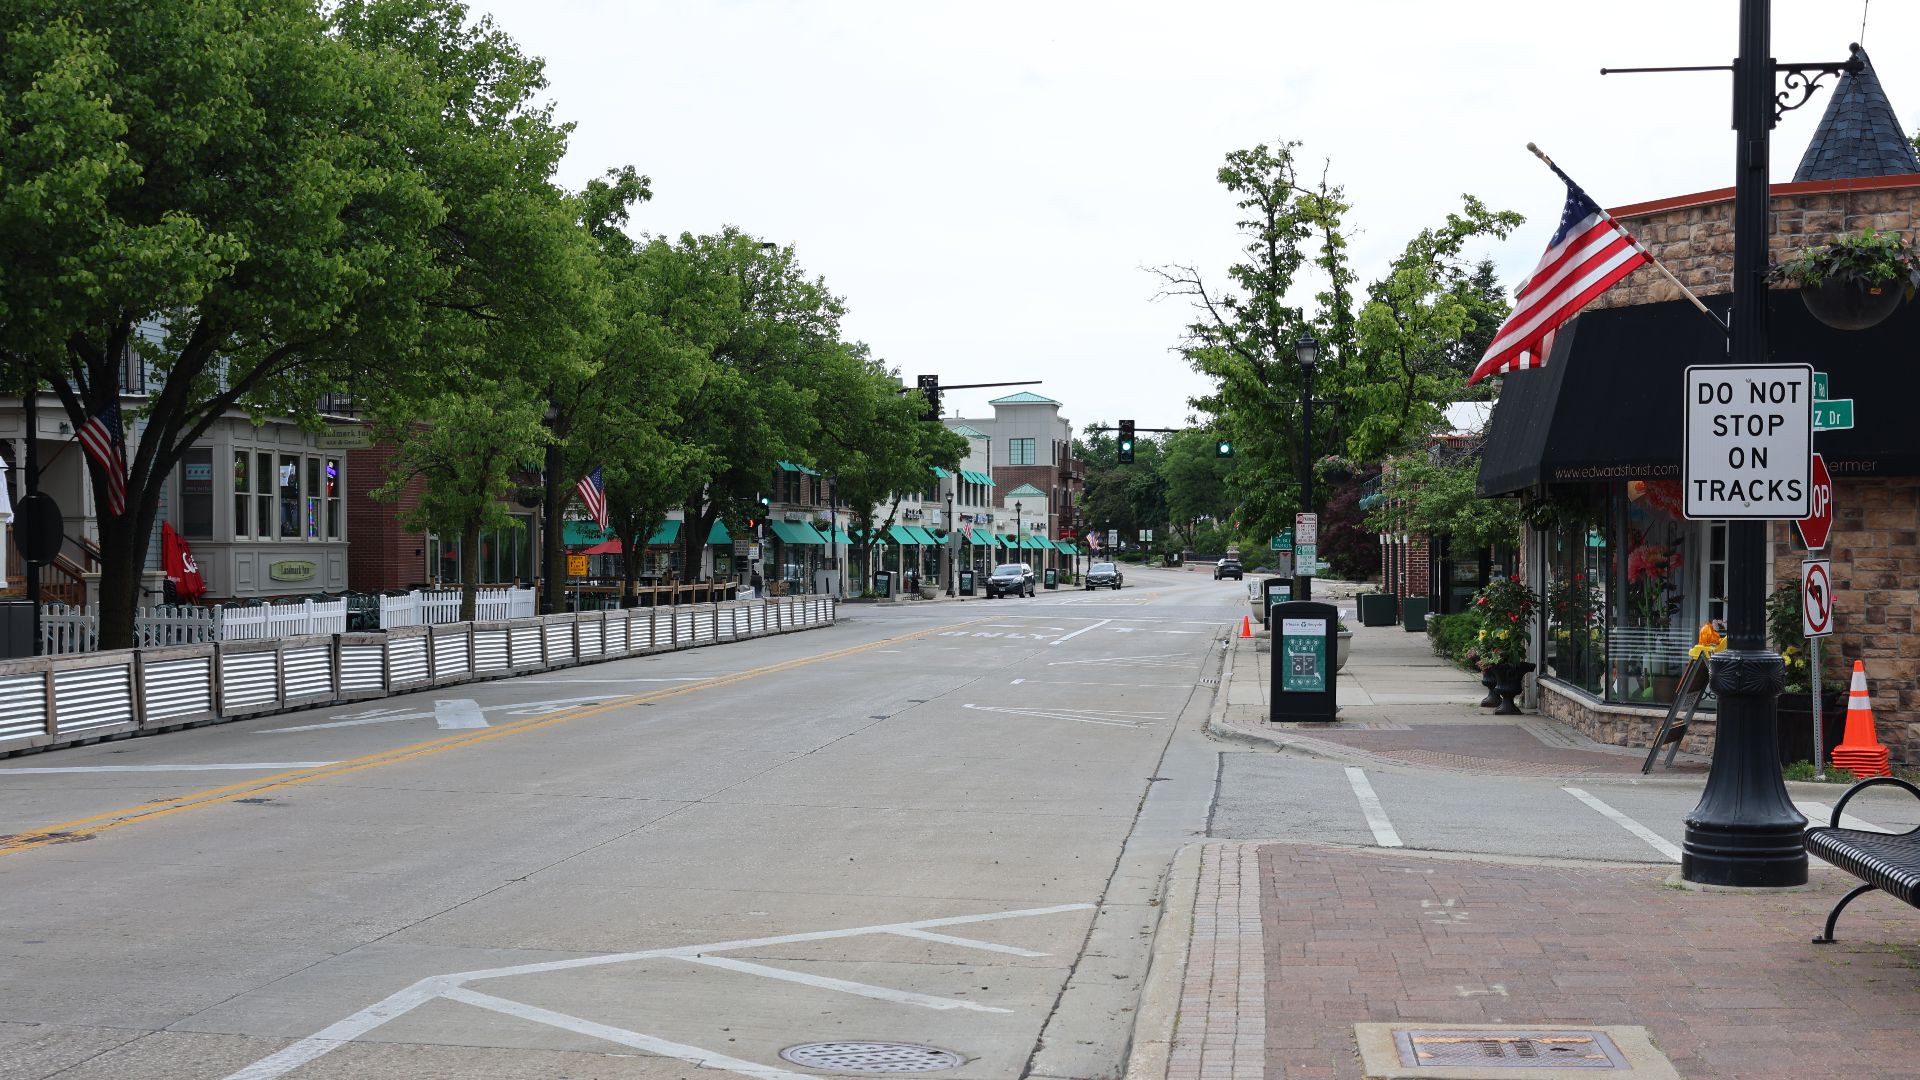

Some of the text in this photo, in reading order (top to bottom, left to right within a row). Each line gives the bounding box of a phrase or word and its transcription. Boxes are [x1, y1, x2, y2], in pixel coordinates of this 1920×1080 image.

[1699, 382, 1732, 404] DO
[1750, 382, 1801, 404] NOT
[1819, 383, 1826, 397] Rd
[1829, 410, 1841, 425] Dr
[1713, 415, 1784, 437] STOP
[1729, 446, 1768, 469] ON
[1555, 463, 1679, 479] www.edwardsflorist.com
[1829, 461, 1876, 472] ermer
[1694, 480, 1802, 502] TRACKS
[1813, 484, 1829, 517] OP
[1297, 546, 1302, 555] 2
[280, 564, 301, 575] Landmark
